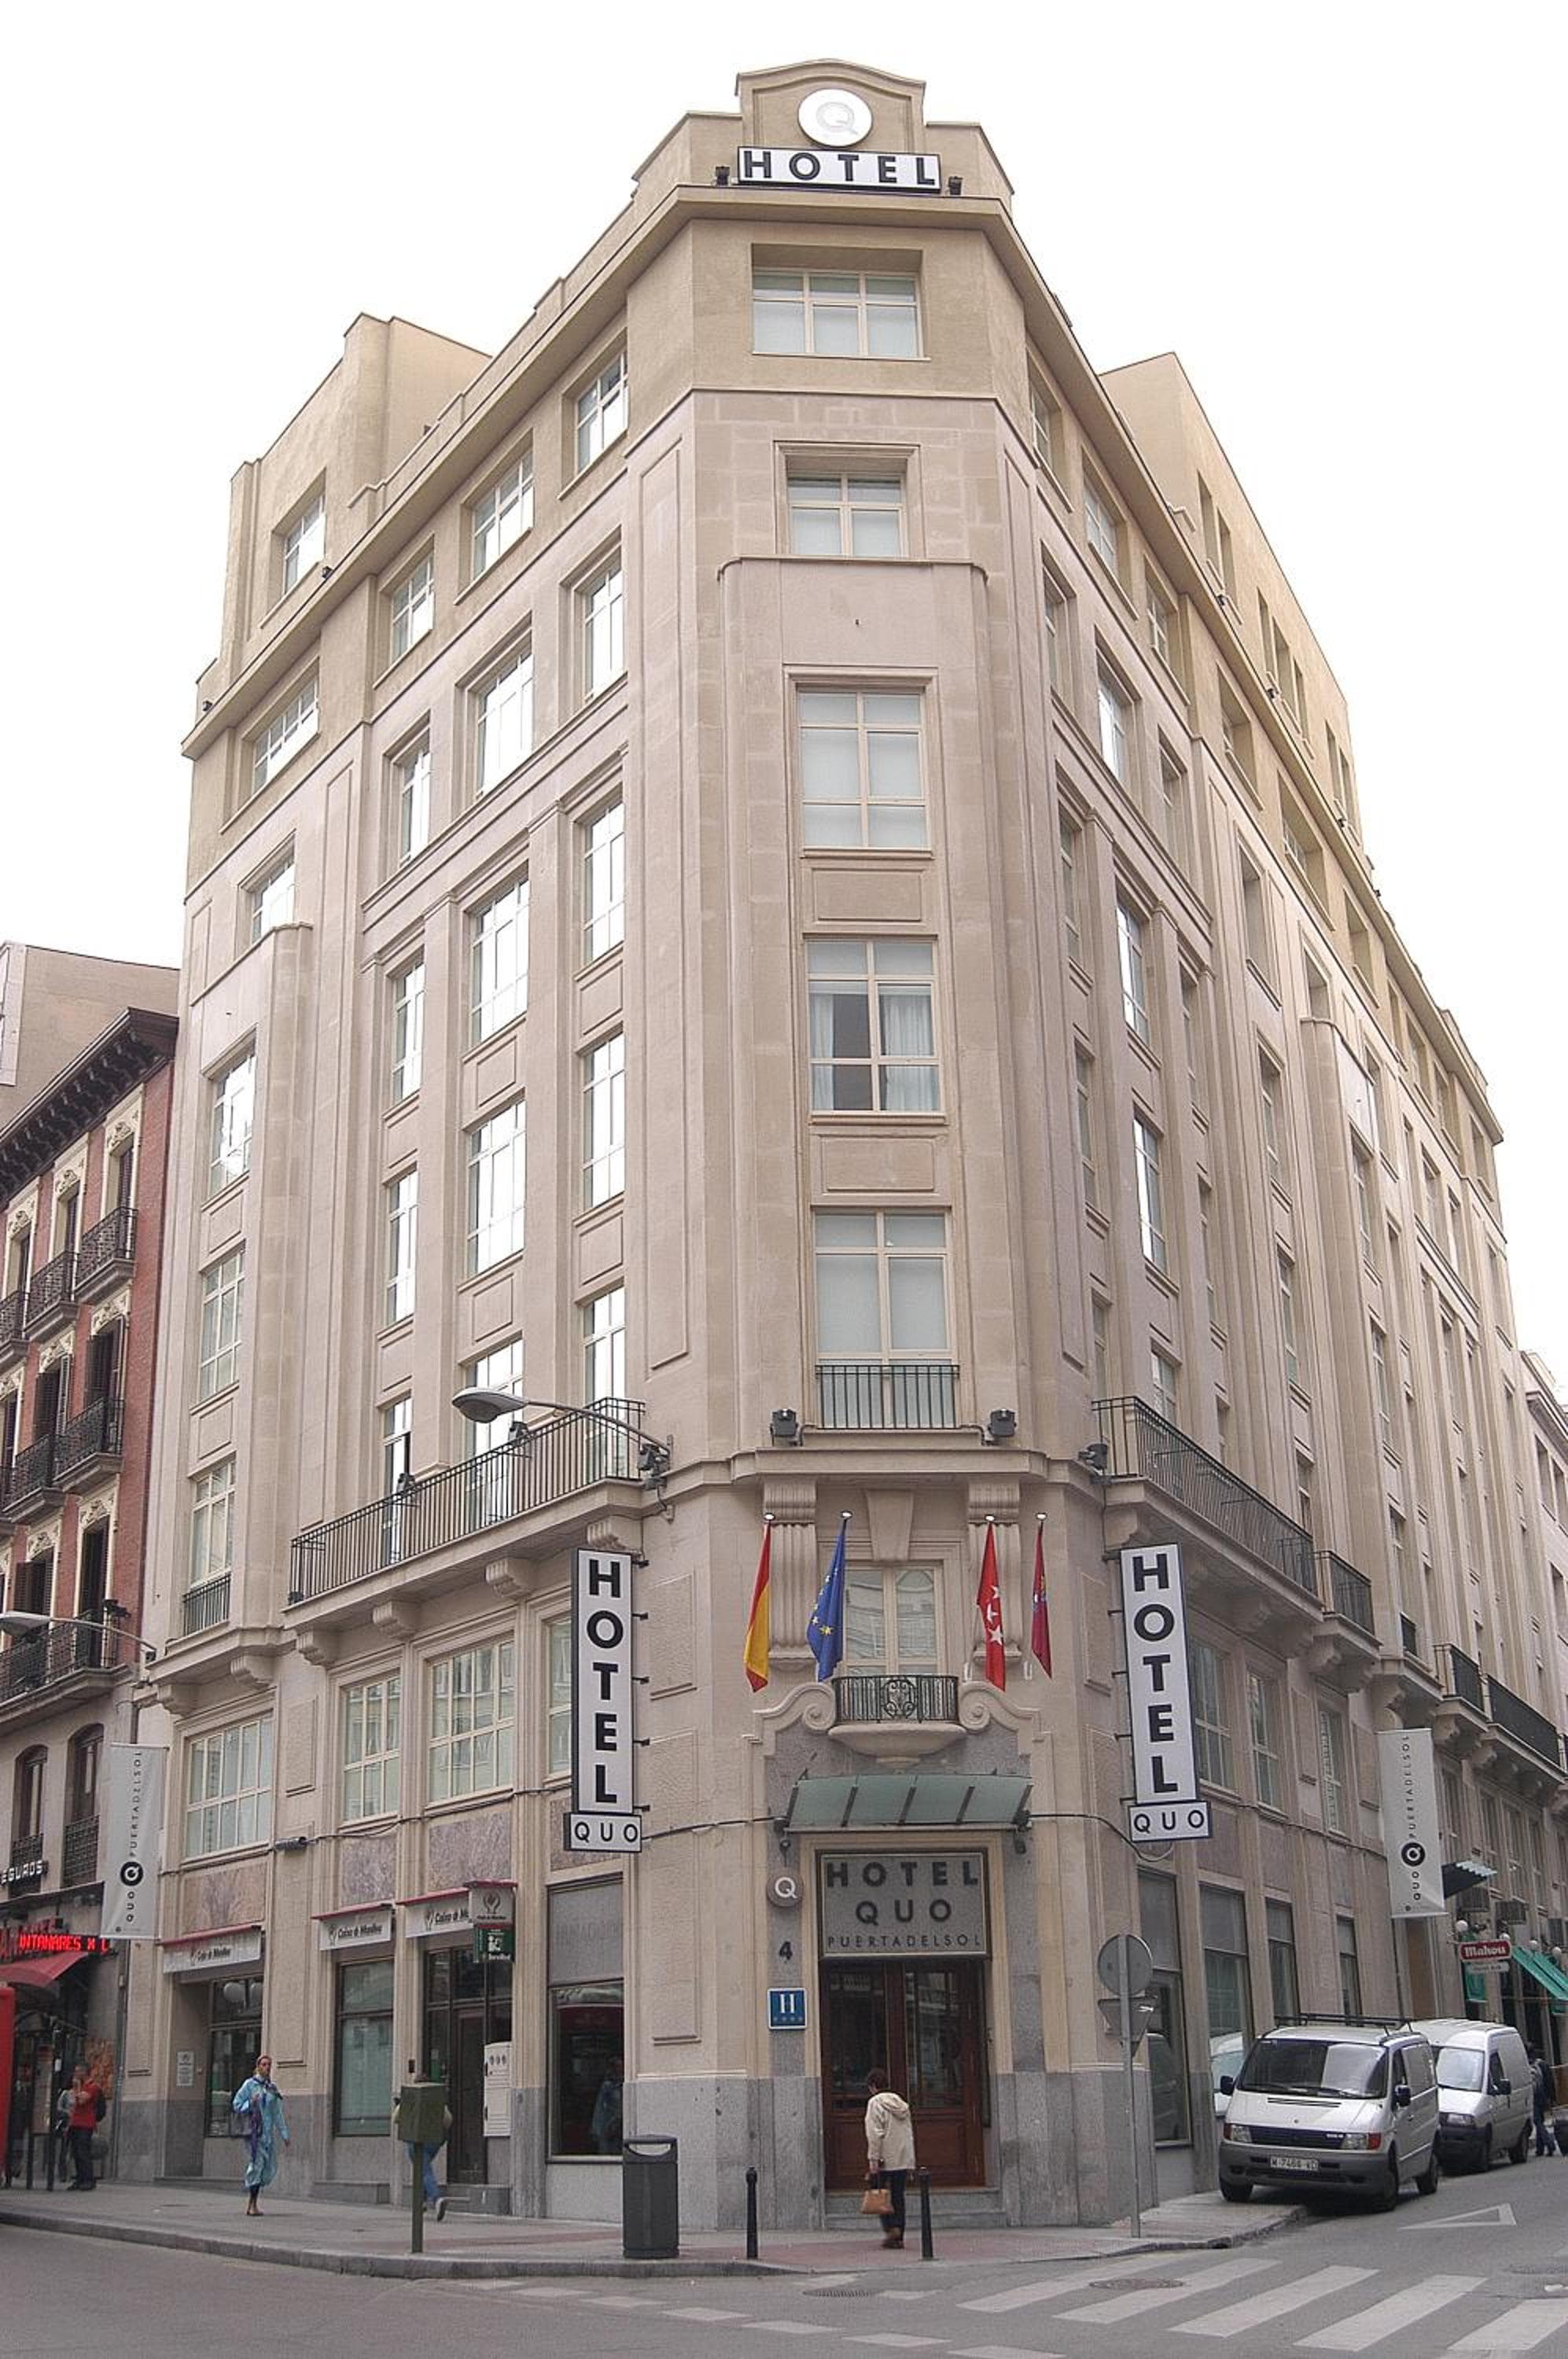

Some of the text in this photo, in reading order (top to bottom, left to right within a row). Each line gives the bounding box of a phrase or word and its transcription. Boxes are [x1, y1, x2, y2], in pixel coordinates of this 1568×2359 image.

[743, 149, 936, 186] HOTEL
[587, 1559, 624, 1803] HOTEL
[1132, 1553, 1179, 1794] HOTEL
[573, 1821, 639, 1844] QUO
[1132, 1809, 1205, 1834] QUO
[826, 1861, 979, 1887] HOTEL
[1412, 1871, 1421, 1901] QUO
[775, 1876, 798, 1899] Q
[126, 1890, 135, 1923] QUO
[856, 1899, 951, 1926] QUO
[778, 1941, 793, 1960] 4
[828, 1934, 980, 1948] PUERTADELSOL
[1464, 1945, 1507, 1957] Mahou
